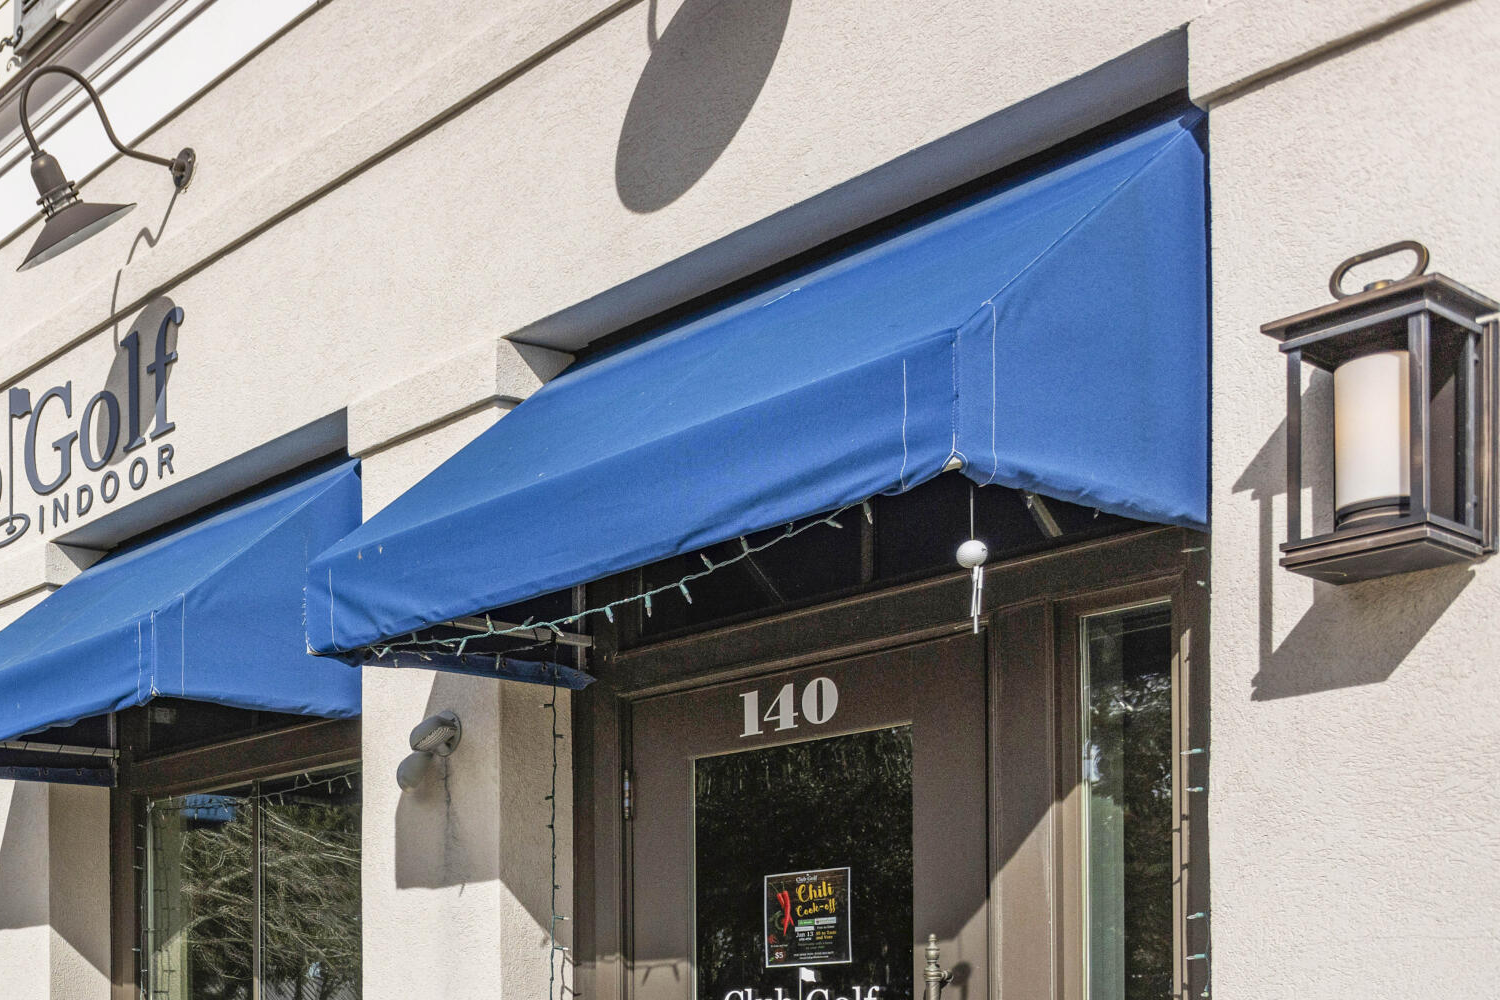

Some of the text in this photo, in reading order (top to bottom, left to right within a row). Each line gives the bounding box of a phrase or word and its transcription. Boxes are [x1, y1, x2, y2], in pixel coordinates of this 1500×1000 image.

[23, 306, 185, 496] Golf
[38, 443, 175, 534] INDOOR
[739, 677, 839, 738] 140
[796, 881, 835, 902] Chili
[796, 898, 836, 917] Cook-off
[775, 951, 784, 959] $5
